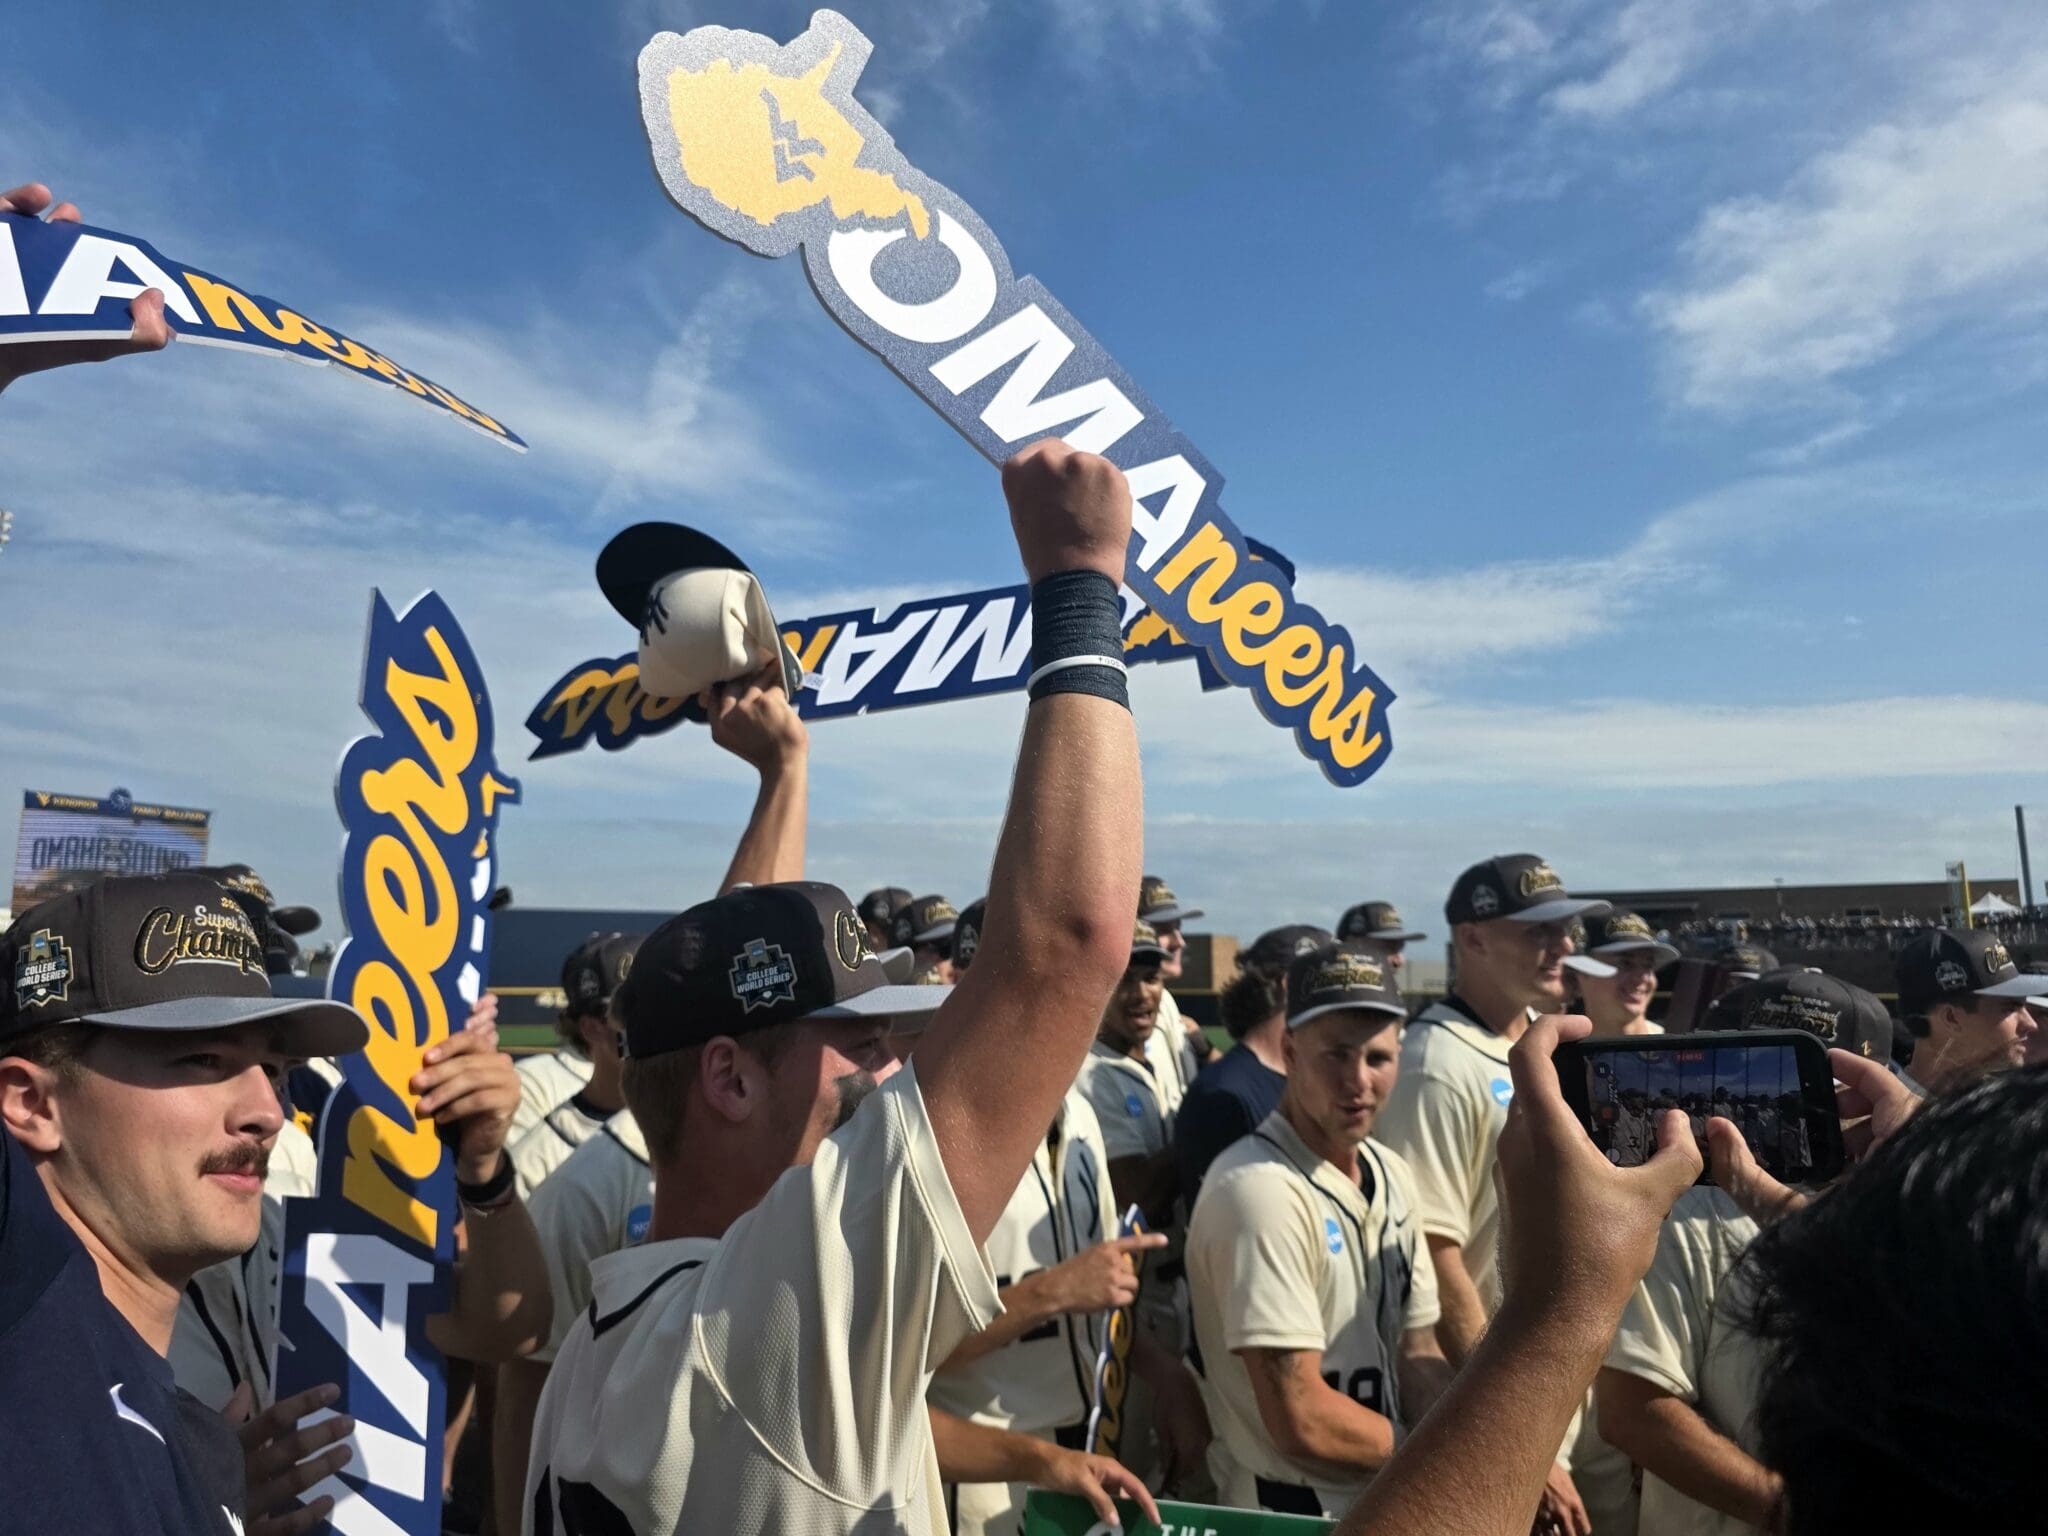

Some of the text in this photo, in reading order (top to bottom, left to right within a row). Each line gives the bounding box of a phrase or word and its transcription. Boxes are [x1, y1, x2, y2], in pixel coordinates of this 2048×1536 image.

[0, 222, 508, 435] Aneers
[827, 208, 1383, 768] OMAneers
[53, 797, 207, 822] KENDRICK FAMILY BALLPARK
[32, 836, 190, 875] OMAHA BOUND
[194, 905, 240, 932] Super
[17, 973, 40, 989] WORLD
[41, 968, 67, 983] SERIES
[25, 961, 57, 977] COLLEGE
[747, 966, 778, 981] COLLEGE
[737, 972, 791, 993] WORLD SERIES
